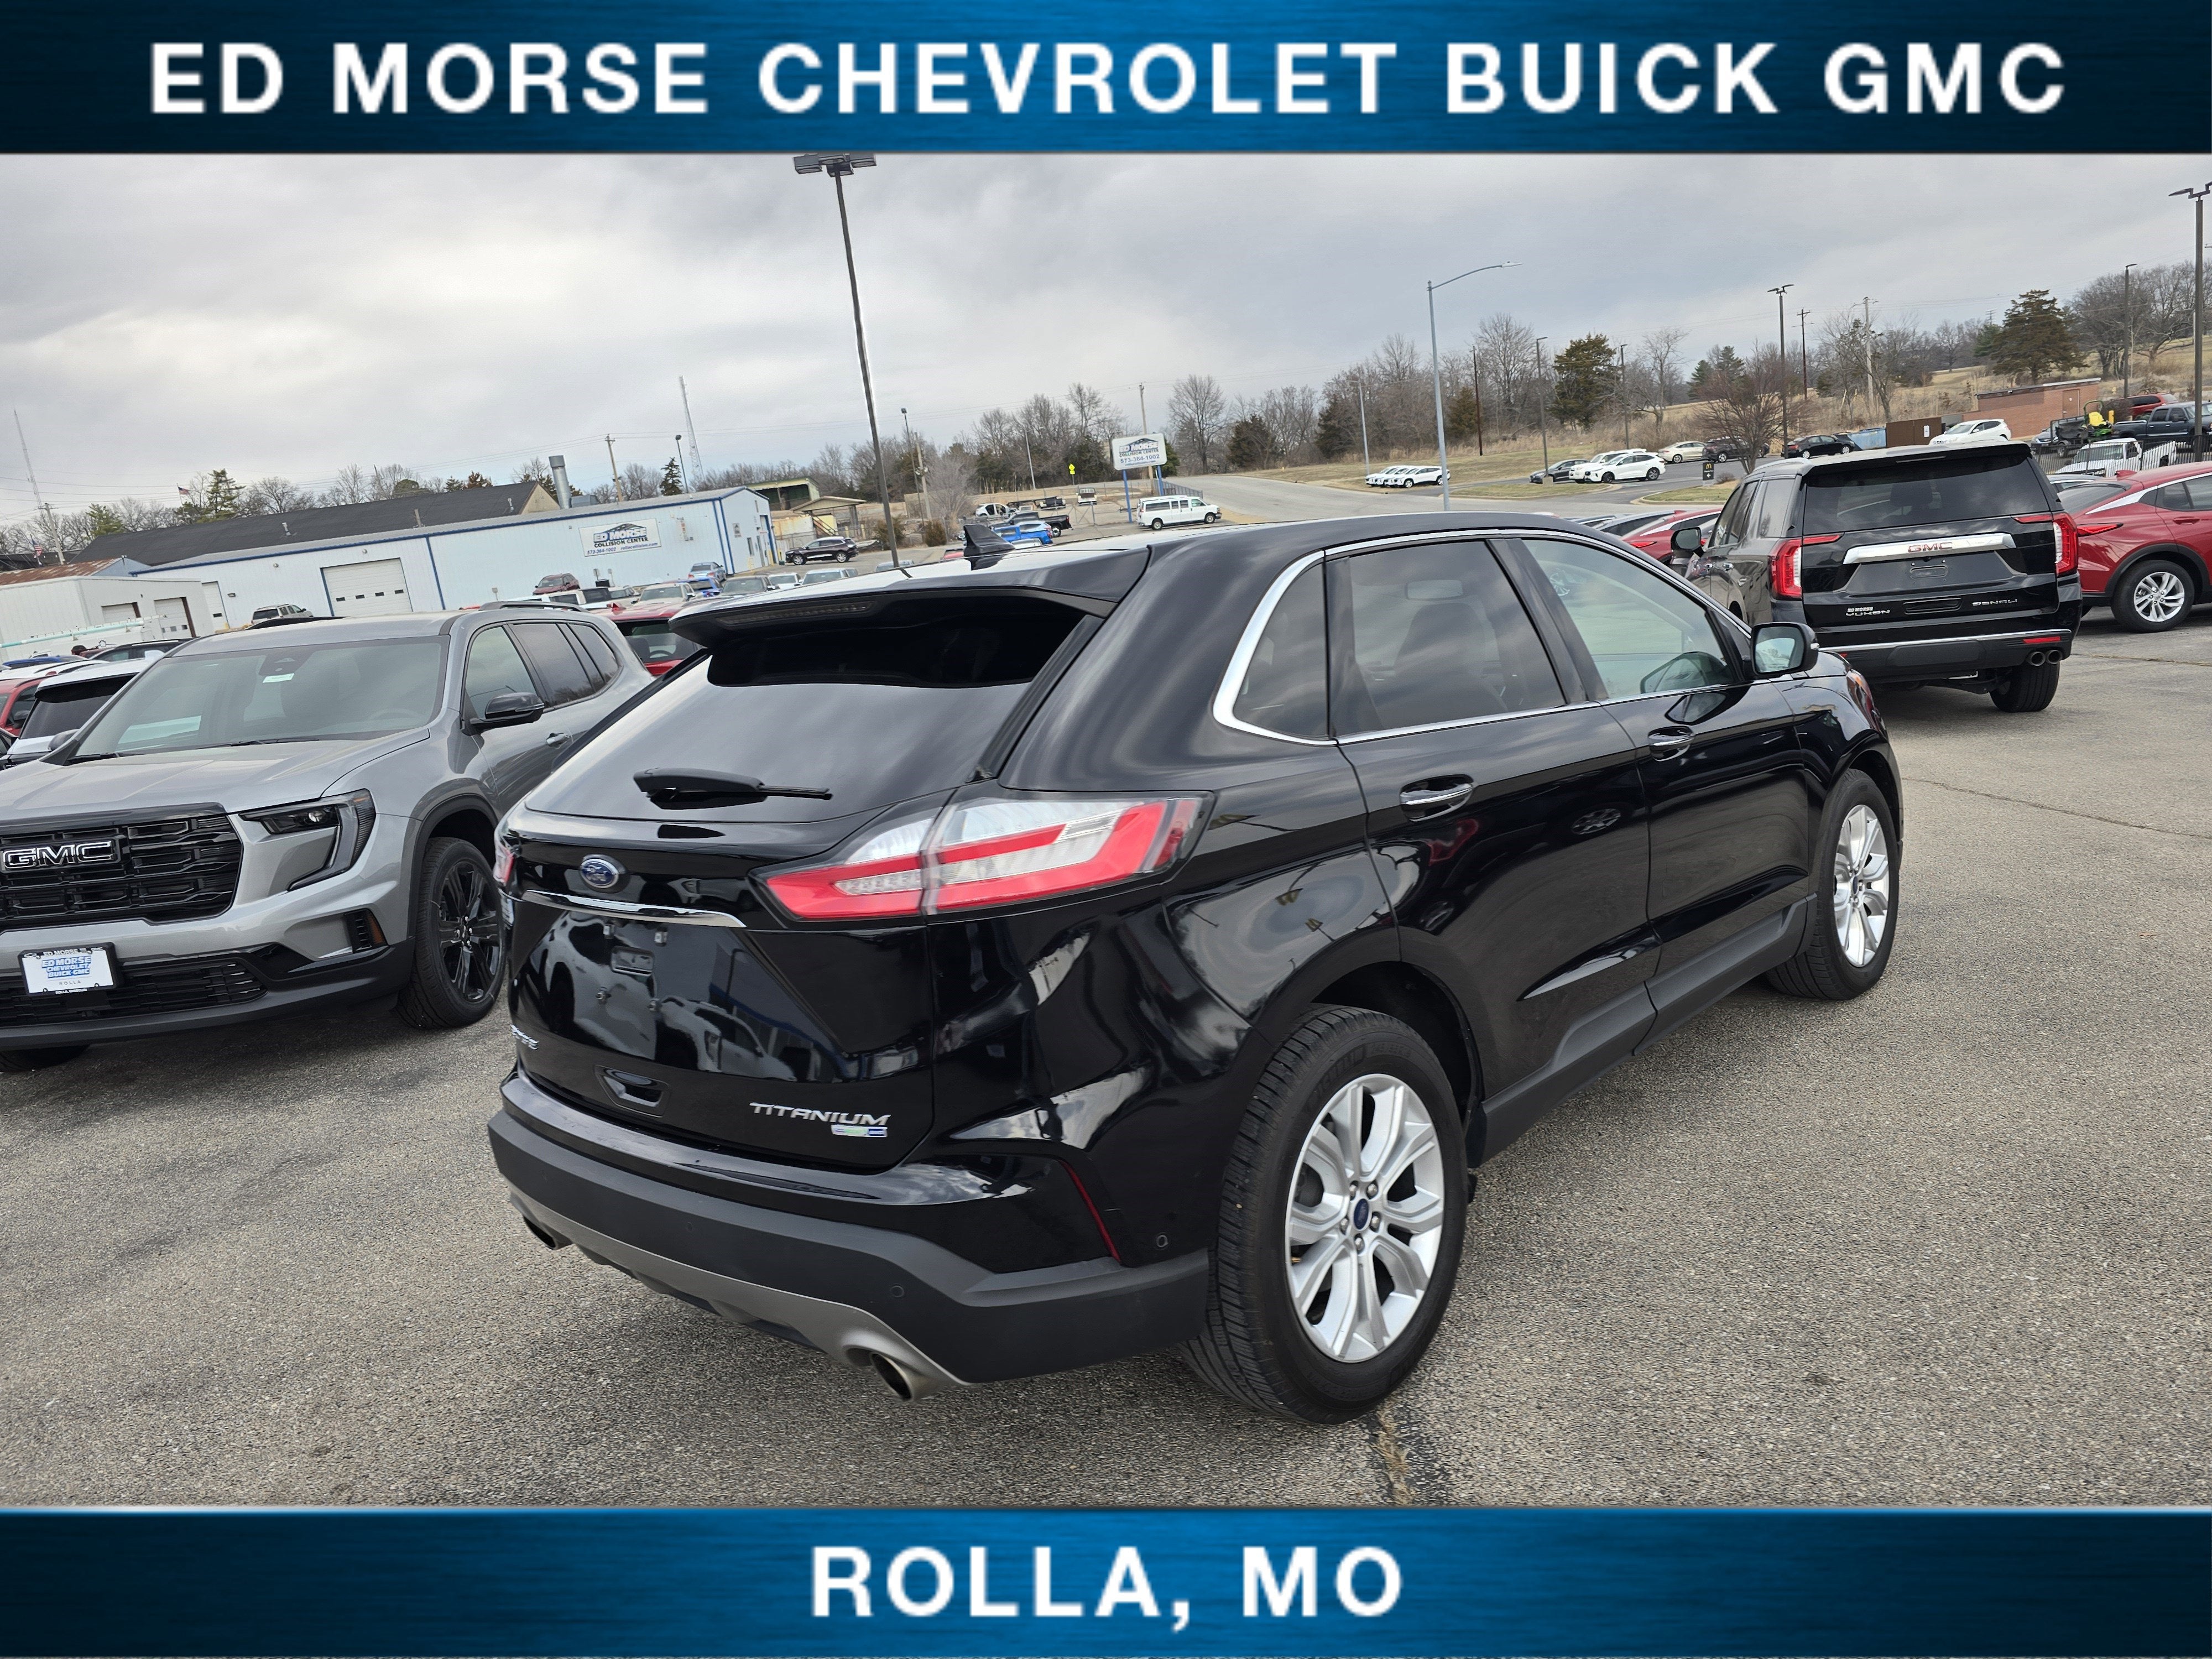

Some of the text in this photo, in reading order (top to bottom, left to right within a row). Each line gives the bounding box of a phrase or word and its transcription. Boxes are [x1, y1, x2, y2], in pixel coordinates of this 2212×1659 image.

[1120, 454, 1160, 463] 573-364-1002
[594, 528, 646, 542] ED MORSE
[1908, 541, 1953, 554] GMC
[1972, 598, 2018, 607] DENALI
[2, 840, 113, 869] GMC
[41, 956, 91, 968] ED MORSE
[46, 964, 89, 973] CHEVROLET
[749, 1102, 891, 1125] TITANIUM
